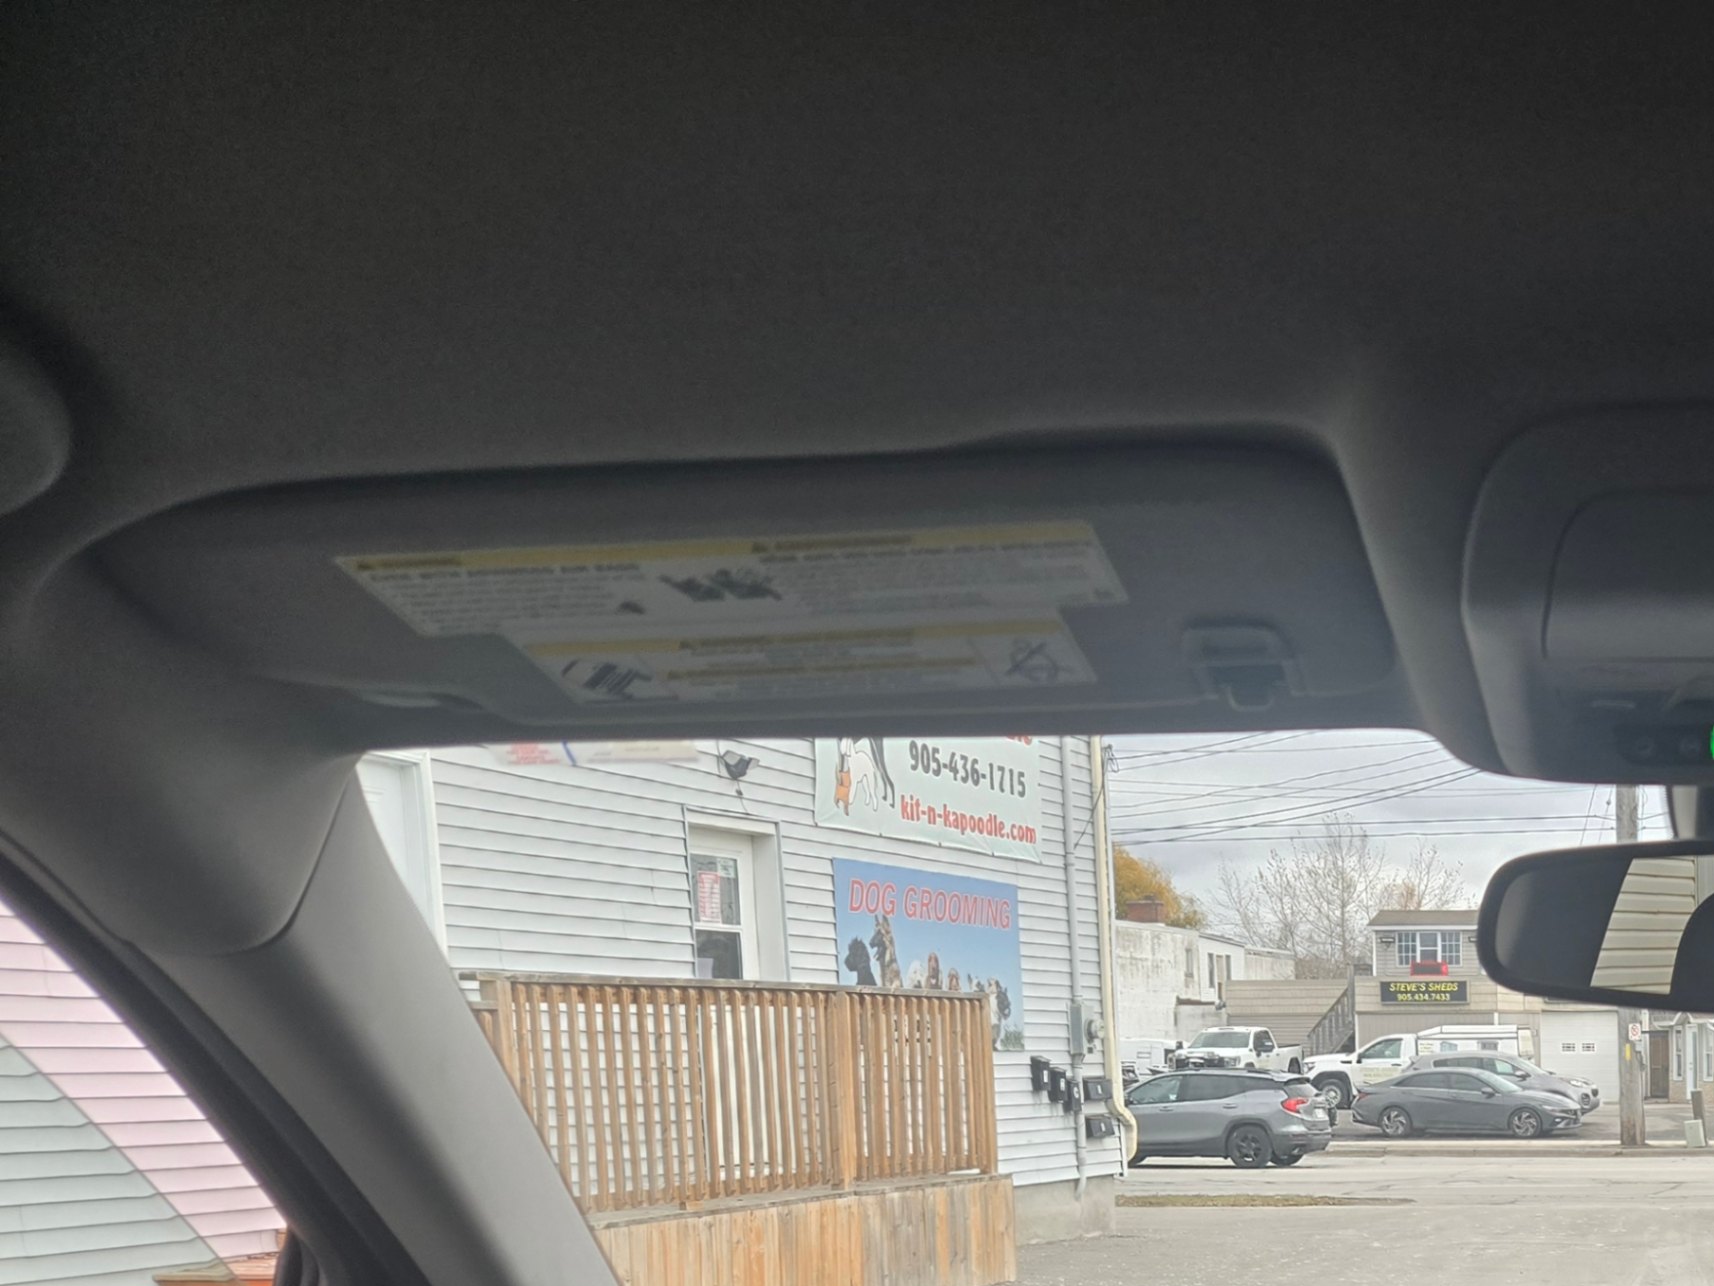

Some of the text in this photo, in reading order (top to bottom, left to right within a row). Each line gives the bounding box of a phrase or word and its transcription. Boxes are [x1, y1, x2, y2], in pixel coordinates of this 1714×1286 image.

[909, 740, 1026, 798] 905-436-1715
[901, 794, 1036, 844] kit-n-kapoodle.com
[850, 879, 1011, 929] DOG GROOMING
[1389, 983, 1458, 991] STEVE'S SHEDS
